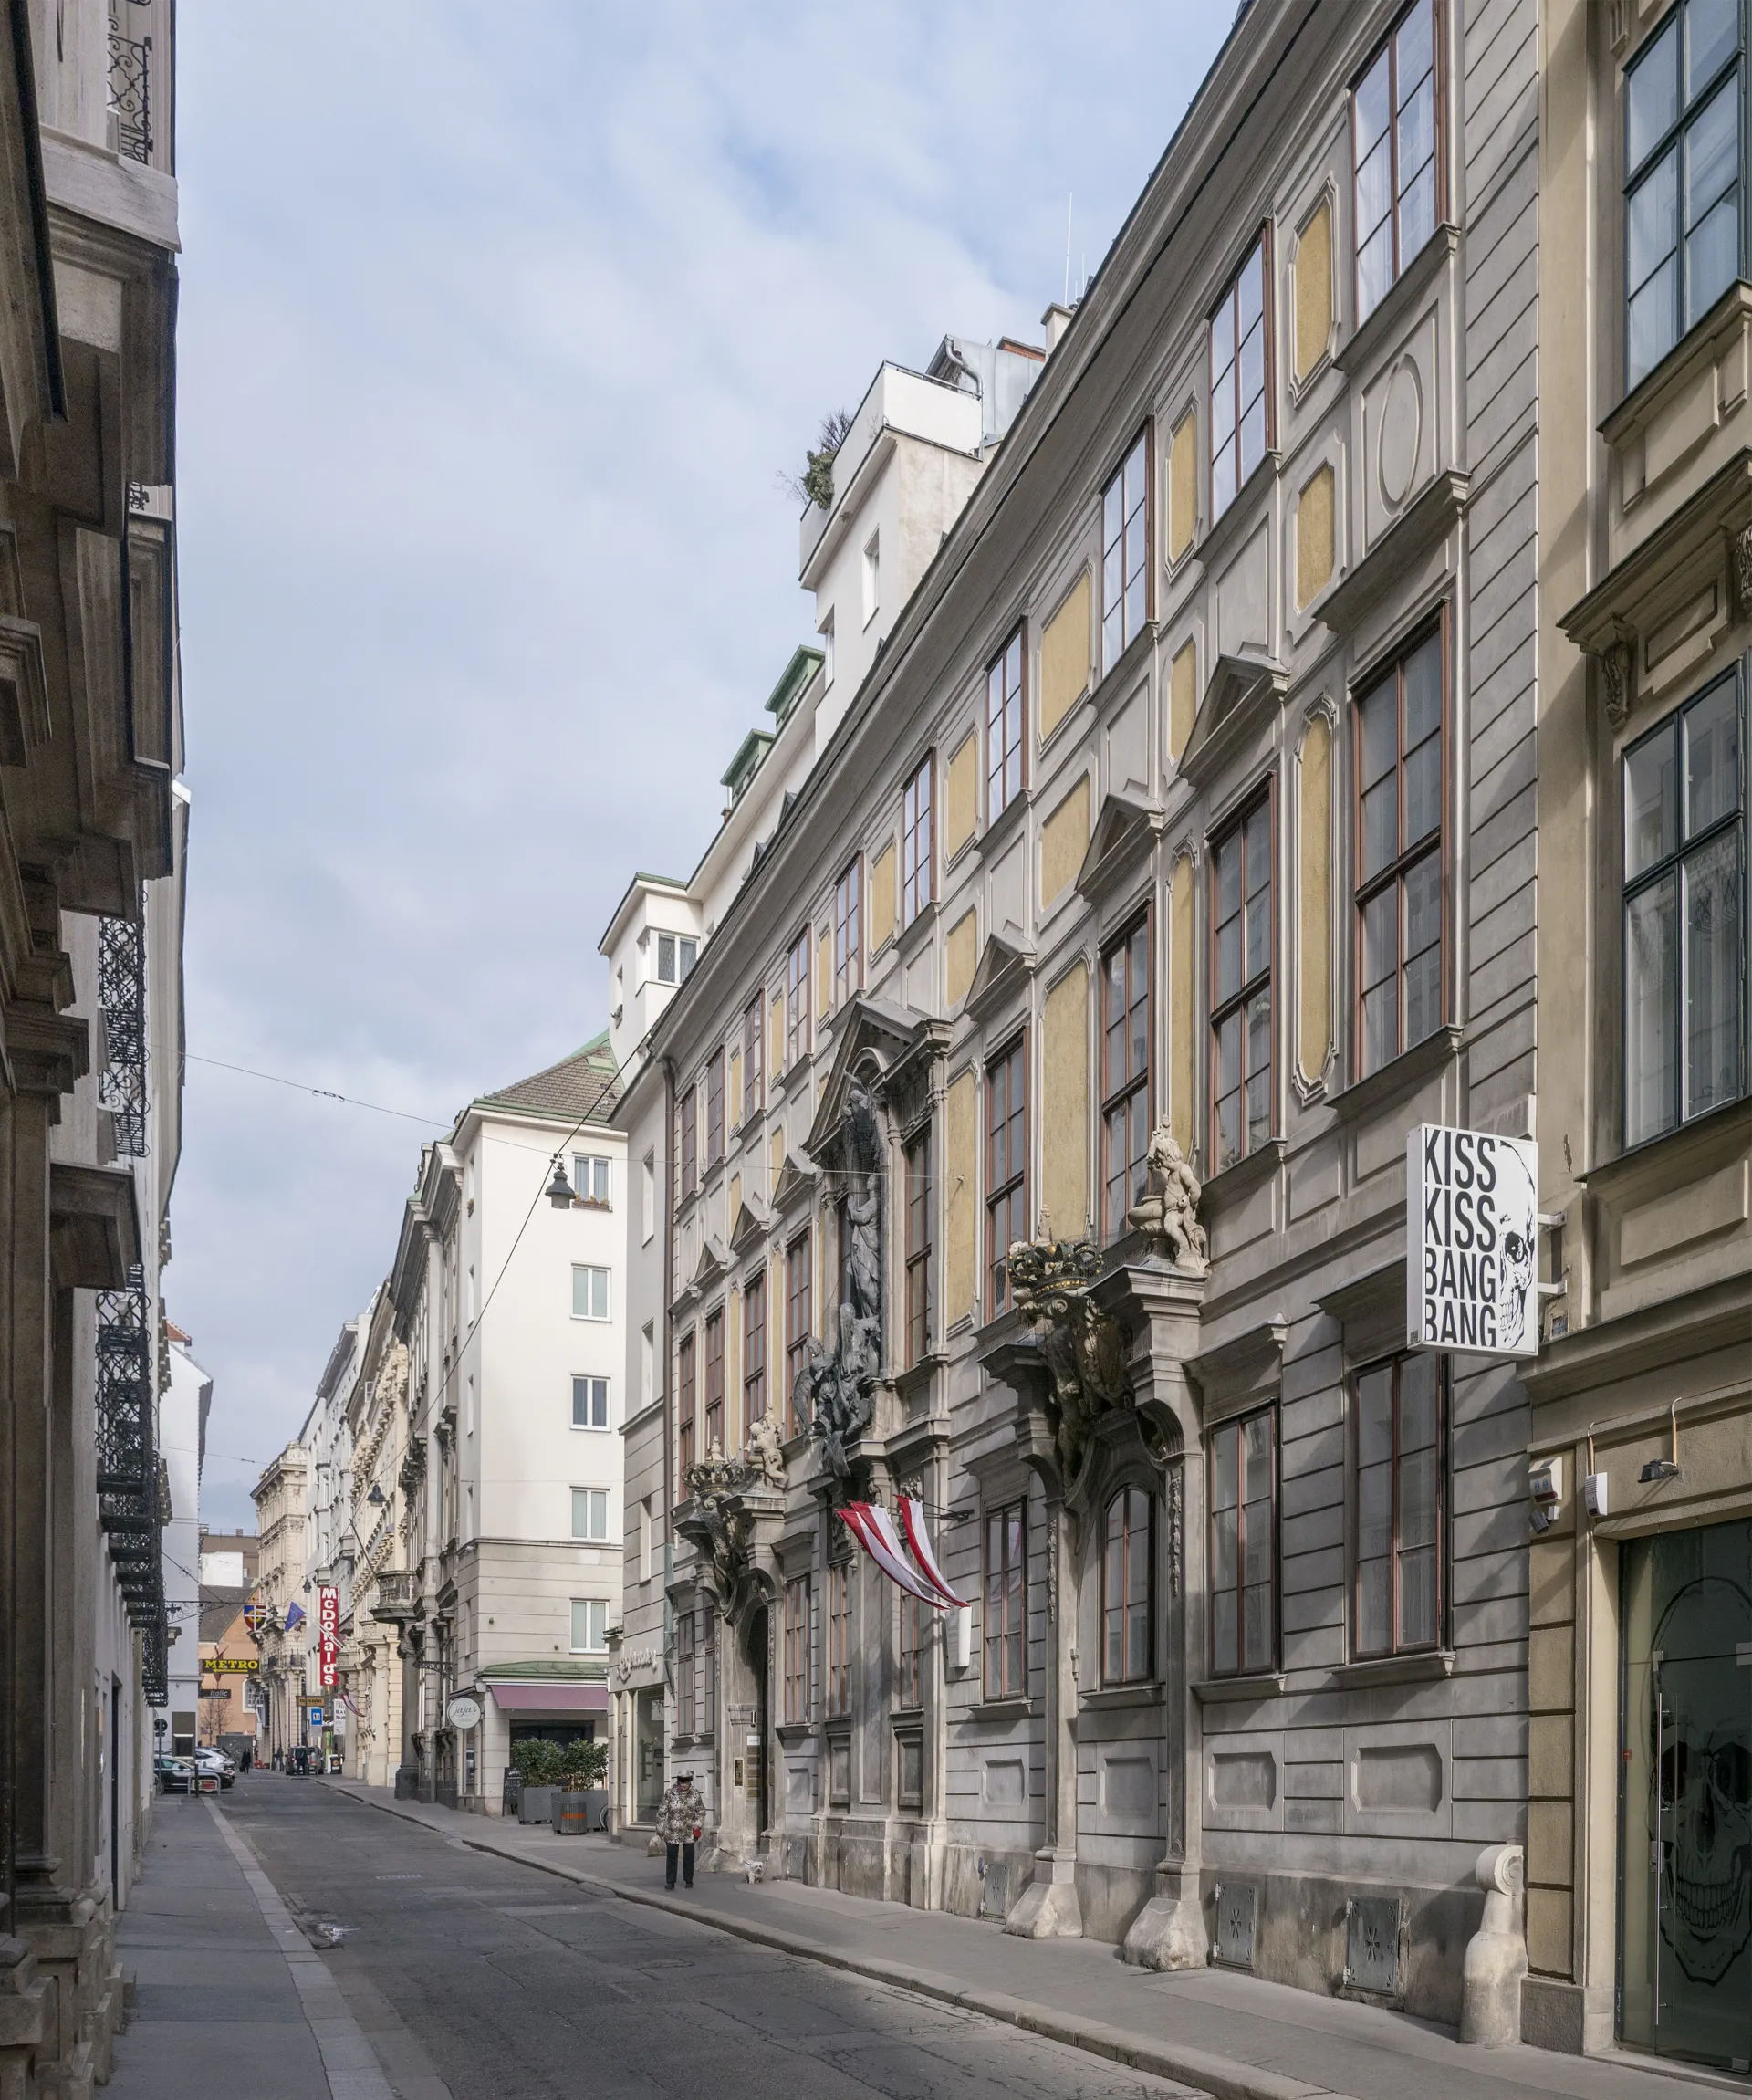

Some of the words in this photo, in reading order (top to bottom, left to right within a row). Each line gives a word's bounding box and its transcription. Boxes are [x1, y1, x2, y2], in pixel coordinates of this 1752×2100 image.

[1425, 1127, 1496, 1193] KISS
[1425, 1186, 1496, 1253] KISS
[1425, 1247, 1496, 1303] BANG
[1425, 1298, 1496, 1348] BANG
[205, 1660, 258, 1669] METRO
